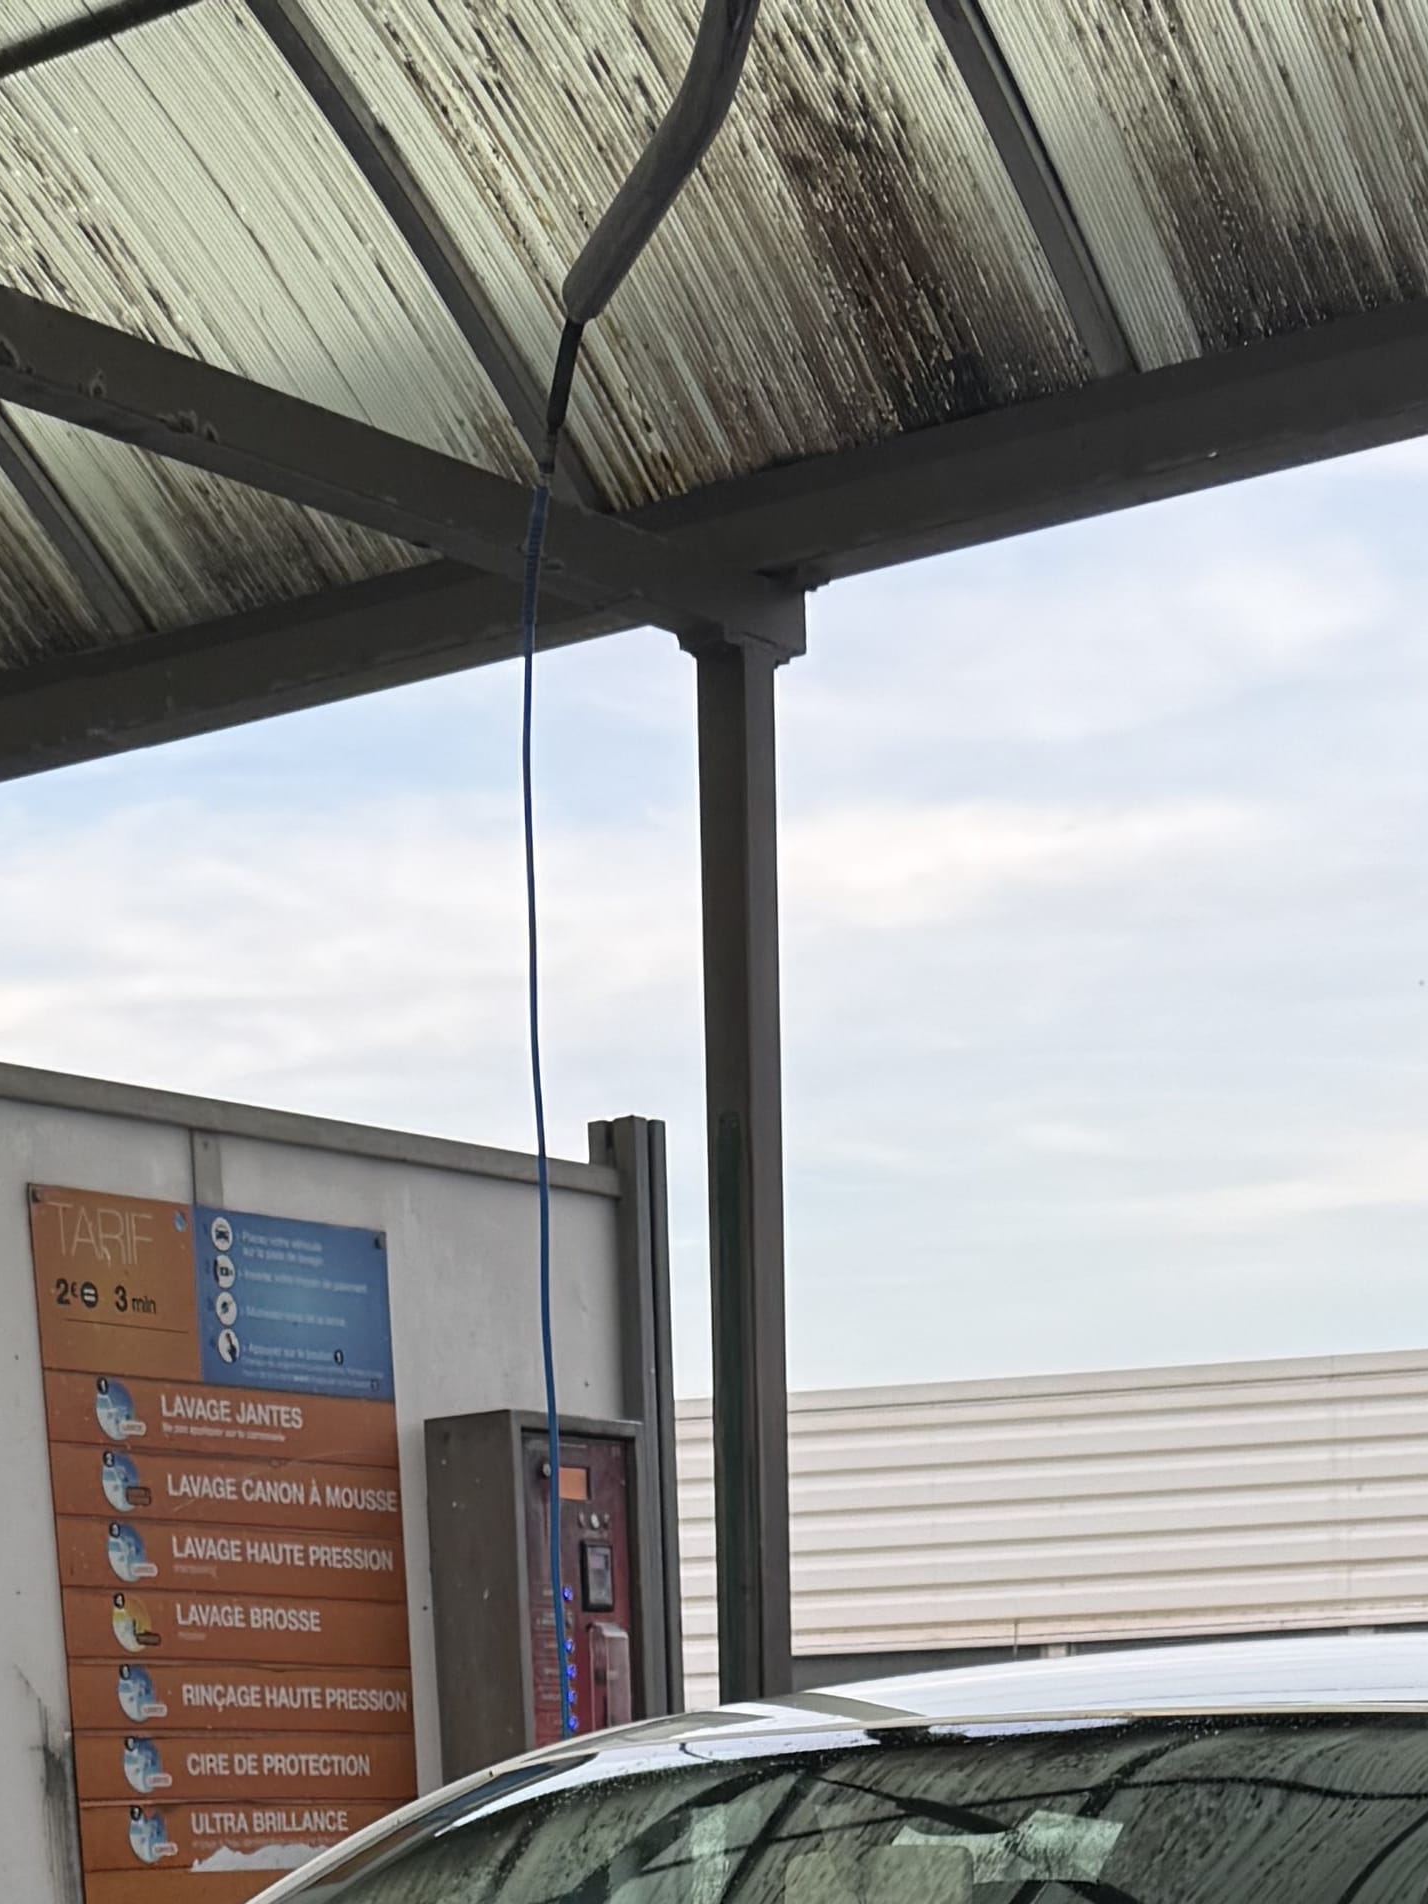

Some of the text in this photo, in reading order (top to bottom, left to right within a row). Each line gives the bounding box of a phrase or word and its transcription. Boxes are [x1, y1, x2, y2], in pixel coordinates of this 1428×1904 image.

[46, 1200, 154, 1266] TARIF
[114, 1285, 128, 1312] 3
[131, 1296, 157, 1314] min
[160, 1394, 303, 1430] LAVAGE JANTES
[166, 1473, 237, 1500] LAVAGE
[241, 1478, 305, 1505] CANON
[310, 1478, 323, 1507] À
[326, 1486, 398, 1513] MOUSSE
[172, 1535, 394, 1572] LAVAGE HAUTE PRESSION
[175, 1603, 321, 1633] LAVAGE BROSSE
[182, 1683, 262, 1713] RINÇAGE
[264, 1687, 323, 1710] HAUTE
[325, 1689, 408, 1713] PRESSION
[186, 1753, 371, 1777] CIRE DE PROTECTION
[190, 1810, 348, 1835] ULTRA BRILLANCE
